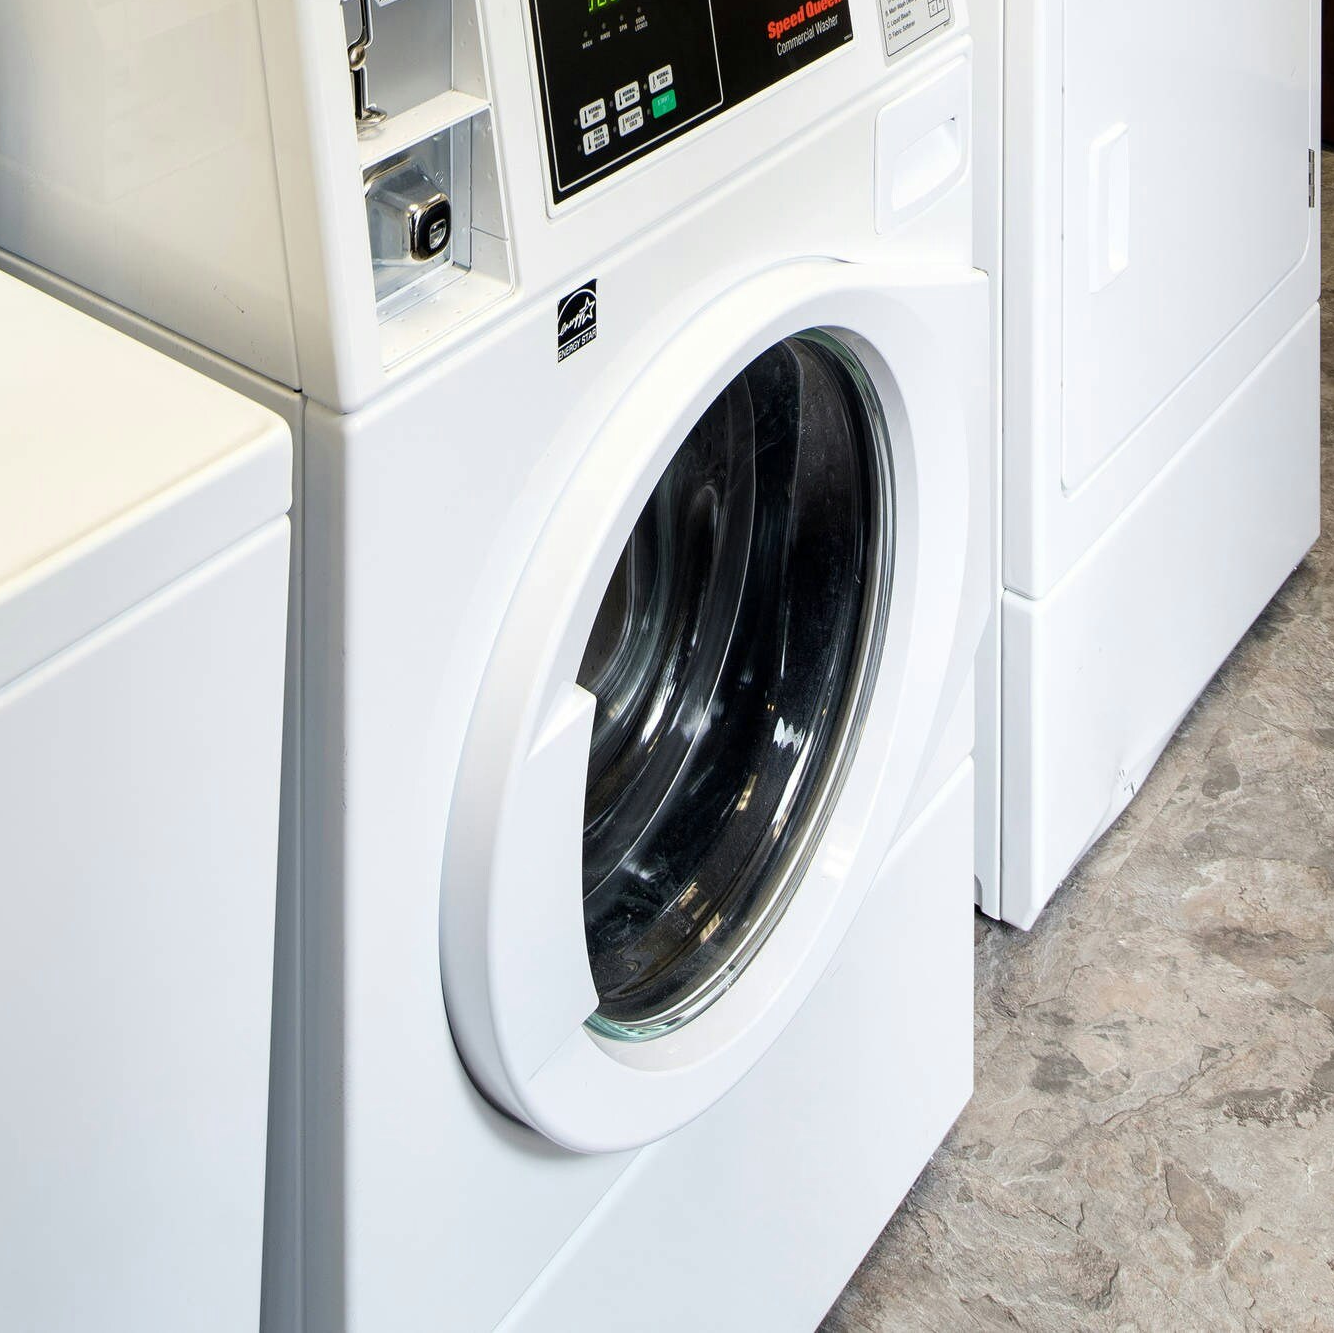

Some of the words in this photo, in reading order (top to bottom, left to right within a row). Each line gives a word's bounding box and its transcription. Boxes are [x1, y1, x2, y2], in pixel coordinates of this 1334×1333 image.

[768, 5, 805, 40] Speed
[776, 26, 815, 56] Commercial
[814, 14, 838, 36] Washer
[558, 338, 581, 361] ENERGY
[581, 328, 597, 346] STAR
